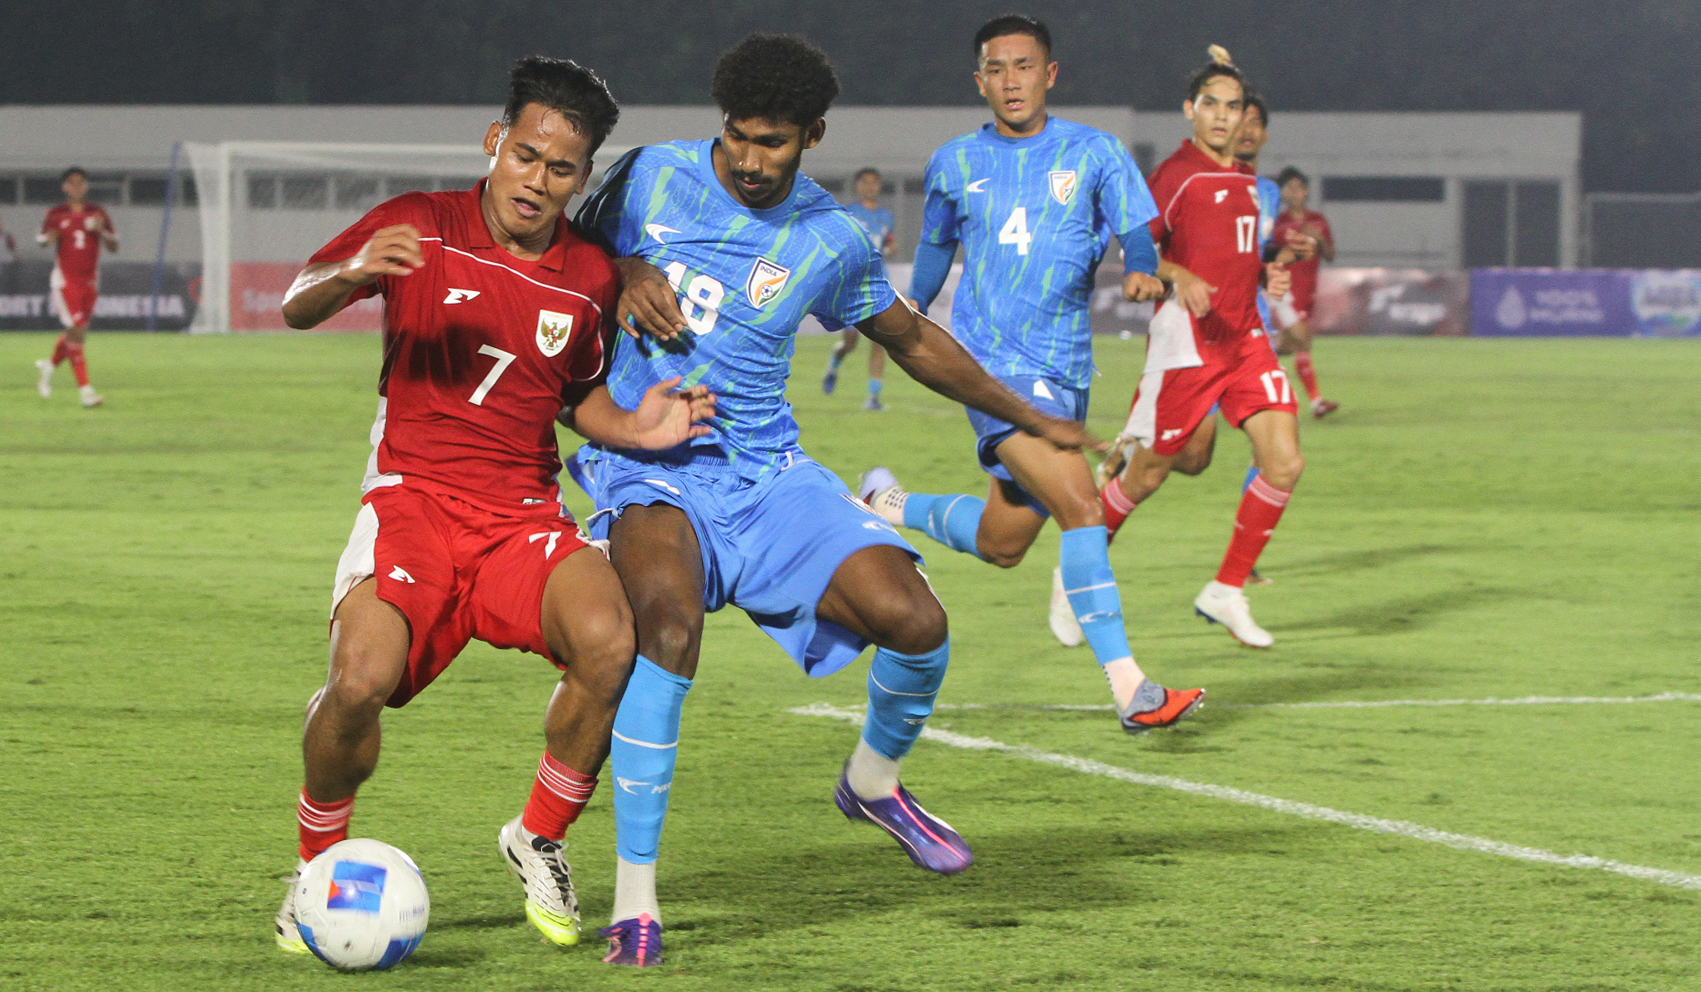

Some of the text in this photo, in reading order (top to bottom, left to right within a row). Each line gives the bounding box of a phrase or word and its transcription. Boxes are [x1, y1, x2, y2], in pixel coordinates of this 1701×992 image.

[998, 207, 1031, 255] 4
[1236, 215, 1256, 253] 17
[759, 264, 778, 278] INDIA
[663, 260, 725, 336] 18
[468, 344, 517, 406] 7
[1260, 370, 1291, 404] 17
[528, 531, 562, 560] 7
